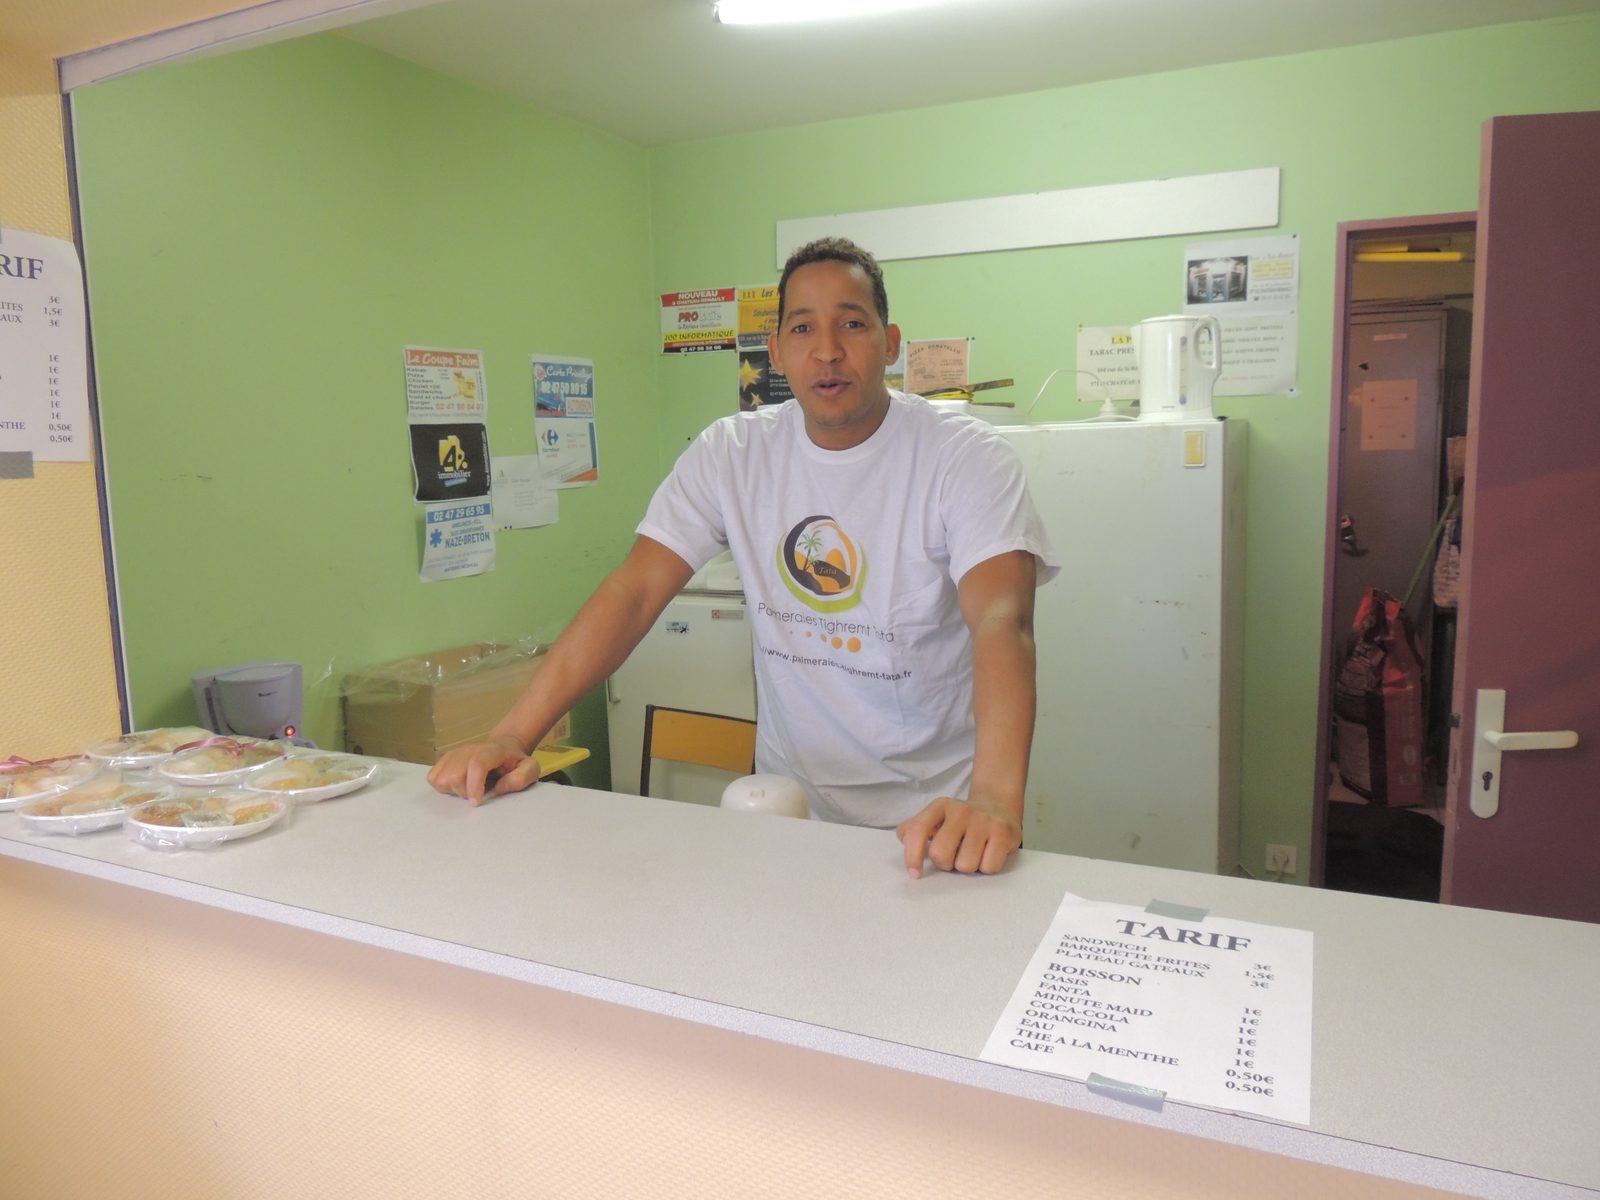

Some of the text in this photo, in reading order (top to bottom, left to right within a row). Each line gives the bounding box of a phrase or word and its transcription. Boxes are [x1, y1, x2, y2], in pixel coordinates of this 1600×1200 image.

[48, 296, 60, 304] 3€
[677, 289, 719, 300] NOUVEAU
[48, 319, 60, 327] 3€
[679, 329, 735, 340] INFORMATIQUE
[48, 354, 60, 362] 1€
[48, 366, 60, 374] 1€
[48, 377, 60, 385] 1€
[49, 389, 61, 397] 1€
[50, 400, 62, 408] 1€
[51, 412, 63, 420] 1€
[48, 423, 73, 433] 0,50€
[49, 434, 73, 444] 0,50€
[433, 511, 444, 522] 02
[445, 509, 455, 520] 47
[1116, 919, 1252, 952] TARIF
[1059, 941, 1153, 962] BARQUETTE
[1156, 955, 1211, 970] FRITES
[1062, 933, 1271, 972] SANDWICH 3€
[1048, 962, 1143, 986] BOISSON
[1055, 948, 1269, 989] PLATEAU GATEAUX 3€
[1043, 973, 1089, 987] OASIS
[1038, 981, 1091, 997] FANTA
[1034, 990, 1103, 1009] MINUTE
[1106, 1003, 1153, 1017] MAID
[1030, 1000, 1130, 1024] COCA-COLA
[1020, 1018, 1056, 1031] EAU
[1025, 1009, 1118, 1032] ORANGINA
[1015, 1028, 1275, 1085] THE A LA MENTHE 0,50€
[1010, 1039, 1275, 1097] CAFE 0,50€
